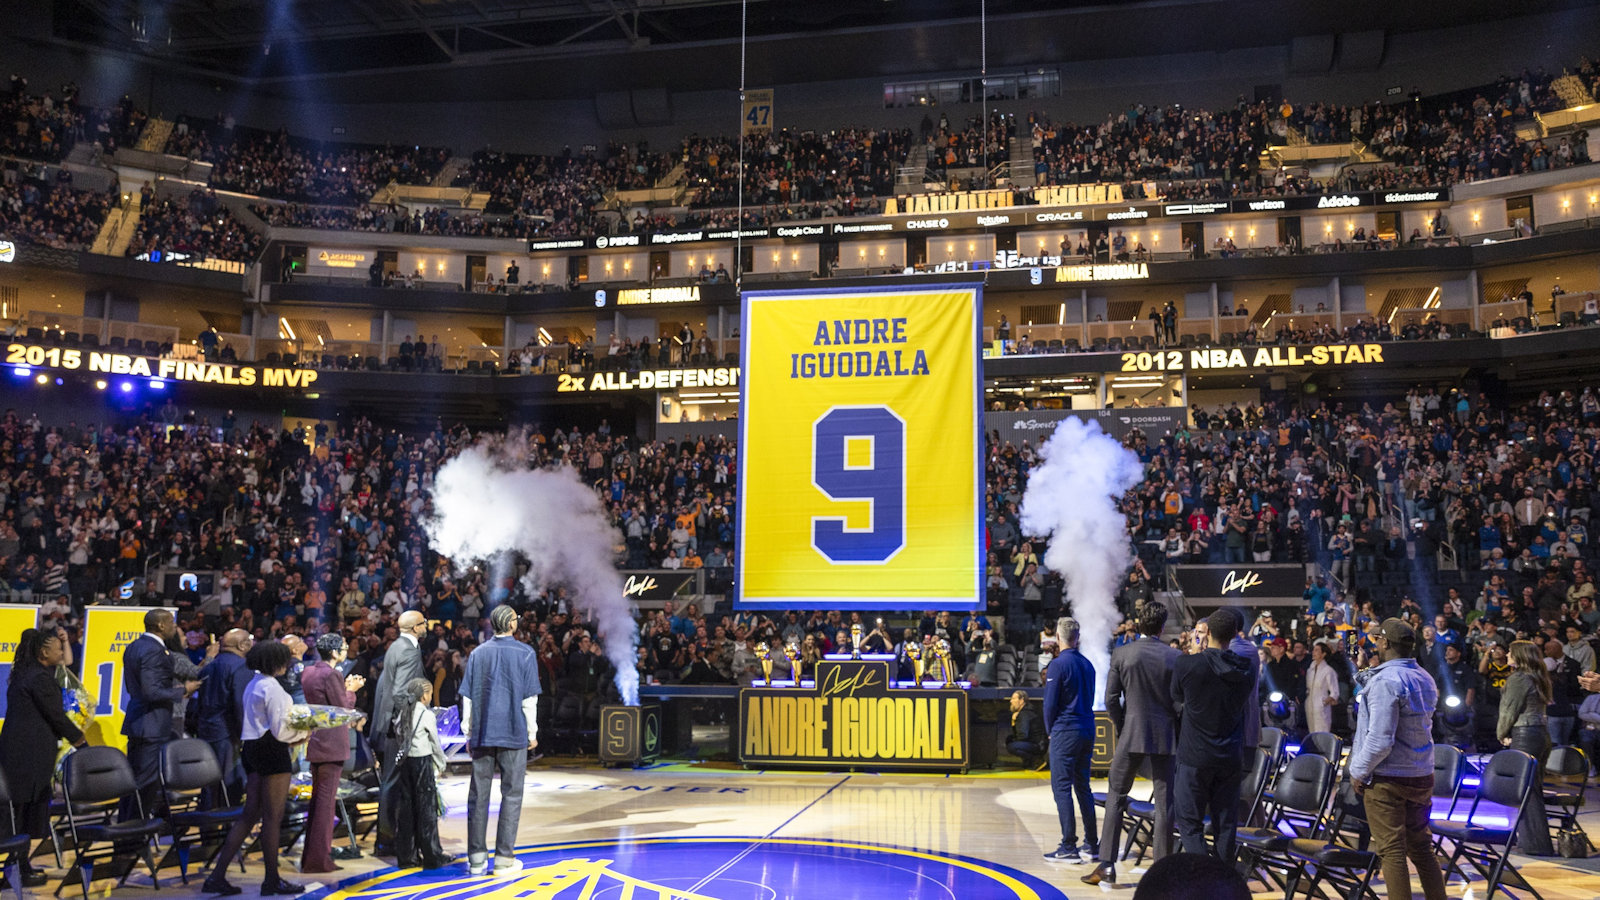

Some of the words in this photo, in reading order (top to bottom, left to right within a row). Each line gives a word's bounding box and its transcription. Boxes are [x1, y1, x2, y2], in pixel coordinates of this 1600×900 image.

[747, 106, 770, 126] 47
[1317, 195, 1360, 208] Adobe
[1385, 191, 1439, 203] ticketmaster
[1249, 200, 1285, 210] verizon
[977, 215, 1009, 226] Rakuten
[1036, 212, 1083, 222] ORACLE
[1107, 209, 1148, 221] accenture
[906, 219, 939, 229] CHASE
[652, 231, 703, 243] RingCentral
[708, 231, 732, 239] UNITED
[777, 227, 803, 237] Google
[803, 226, 824, 235] Cloud
[609, 236, 639, 247] PEPSI
[1030, 267, 1042, 285] 9
[1055, 266, 1092, 282] ANDRE
[1093, 263, 1149, 281] IGUODALA
[595, 289, 607, 307] 9
[617, 289, 650, 305] ANDRE
[650, 286, 701, 303] IGUODALA
[813, 317, 908, 346] ANDRE
[1121, 351, 1184, 372] 2012
[1191, 349, 1247, 369] NBA
[1253, 343, 1384, 367] ALL-STAR
[7, 343, 81, 370] 2015
[89, 351, 151, 377] NBA
[159, 359, 256, 385] FINALS
[262, 367, 318, 388] MVP
[790, 349, 930, 379] IGUODALA
[557, 373, 586, 392] 2x
[1026, 419, 1057, 431] Sports
[1132, 415, 1171, 423] DOORDASH
[810, 404, 907, 565] 9
[1492, 678, 1506, 688] 30
[608, 711, 633, 756] 9
[745, 696, 829, 757] ANDRE
[832, 696, 963, 760] IGUODALA
[558, 784, 750, 794] CENTER
